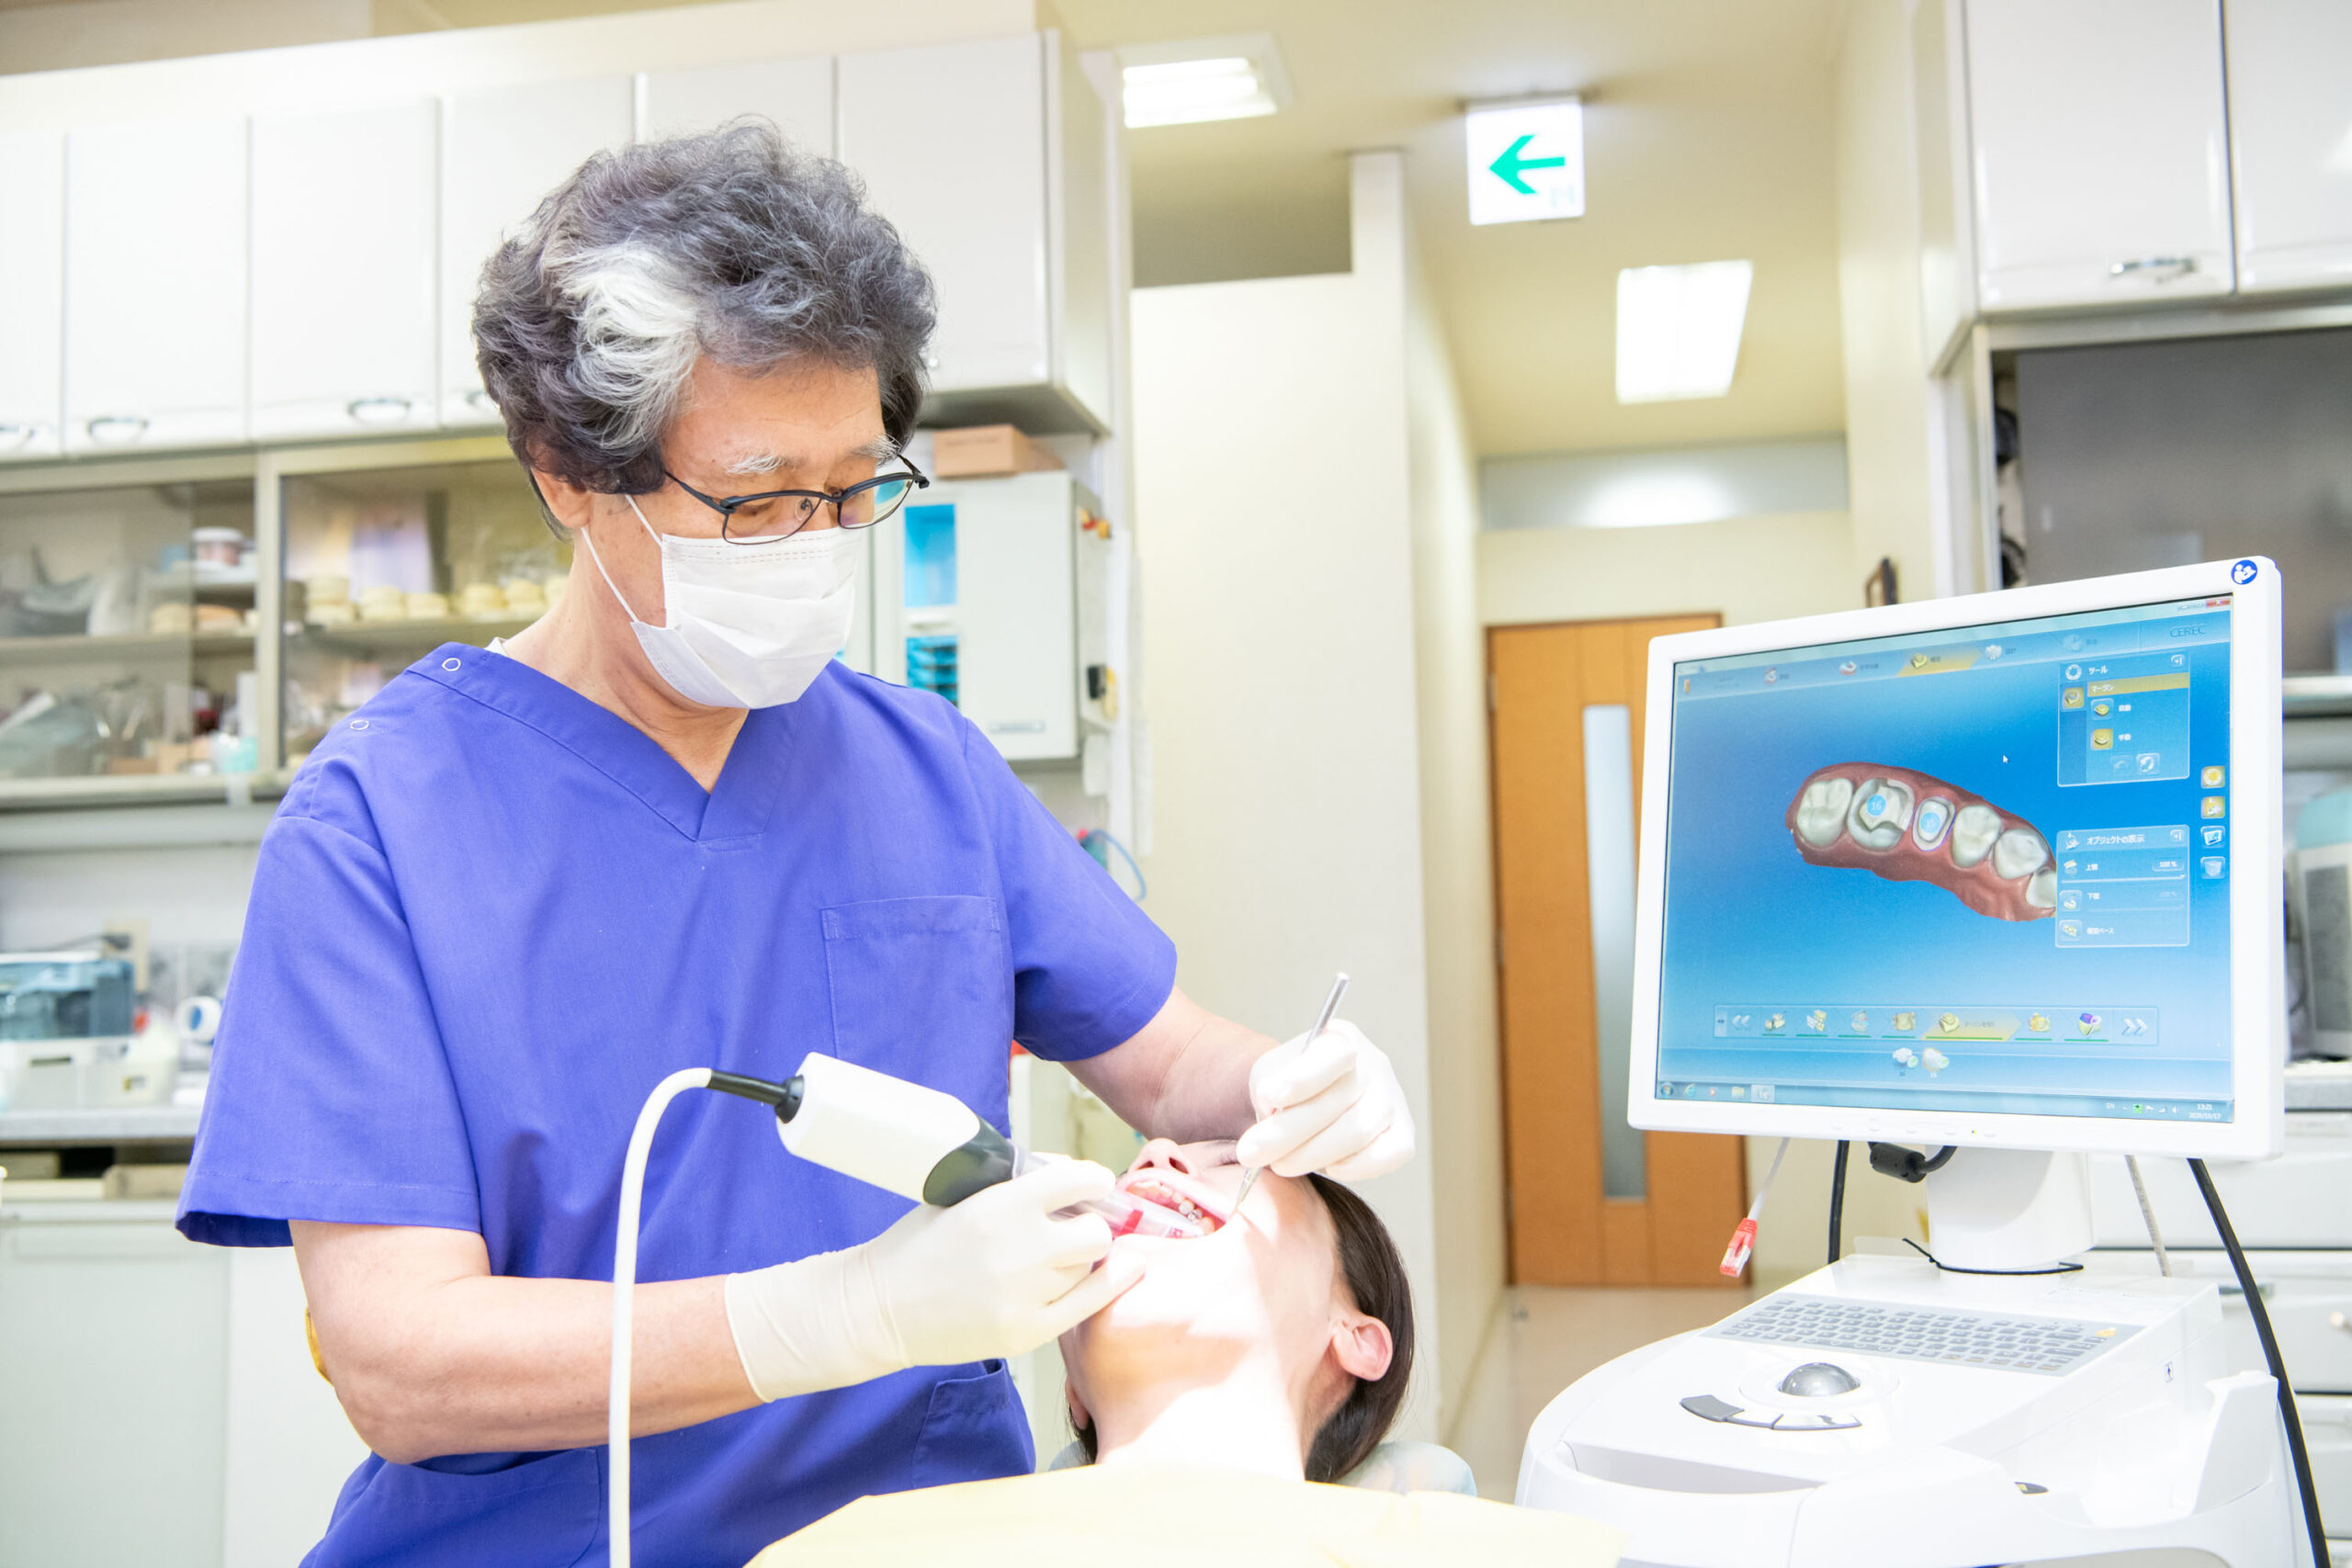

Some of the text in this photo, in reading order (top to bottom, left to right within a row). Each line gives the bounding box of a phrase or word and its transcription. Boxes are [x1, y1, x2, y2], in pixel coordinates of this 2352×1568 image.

[2169, 625, 2206, 637] CEREC
[2088, 664, 2109, 675] ツール
